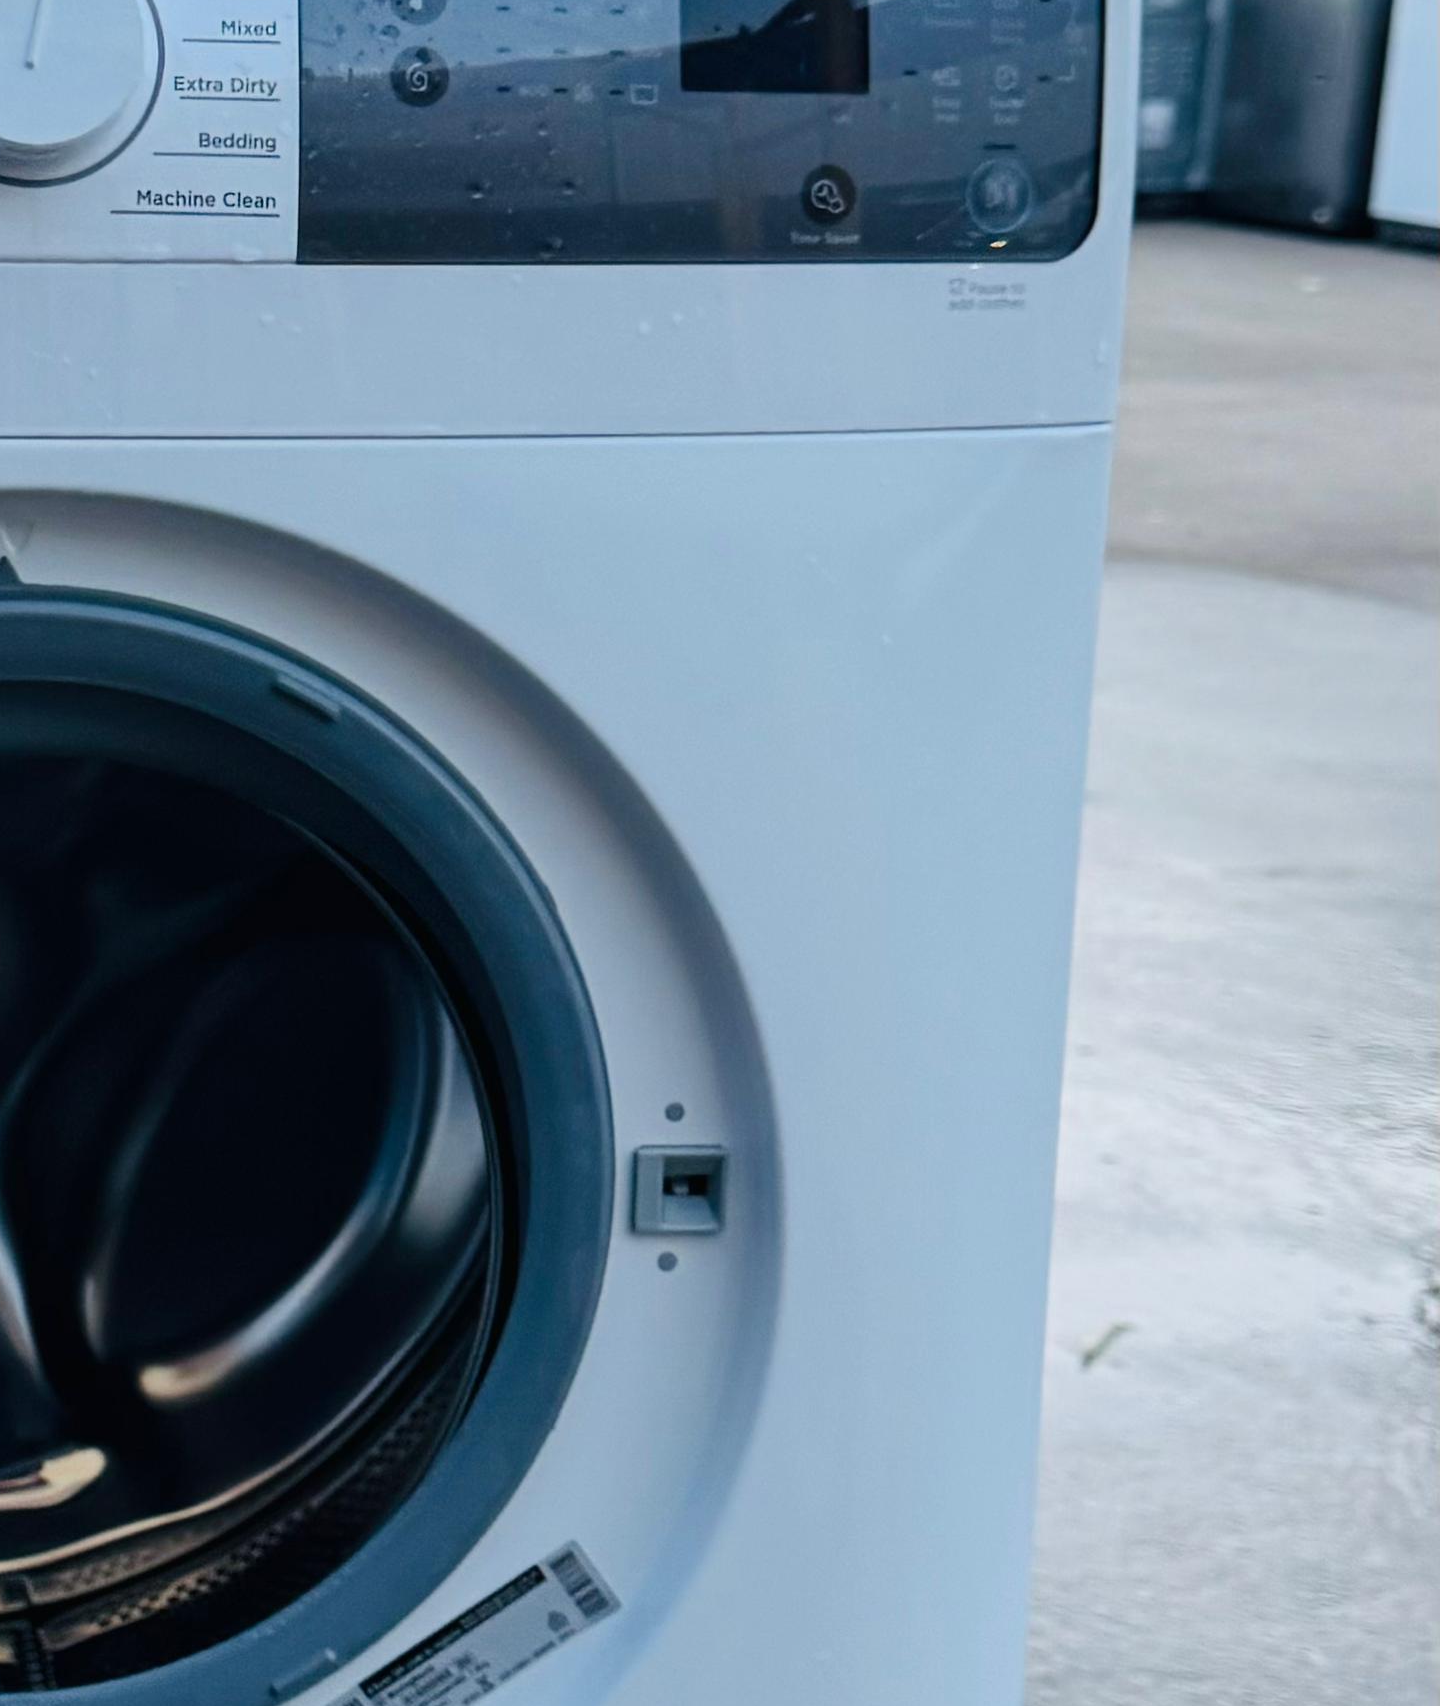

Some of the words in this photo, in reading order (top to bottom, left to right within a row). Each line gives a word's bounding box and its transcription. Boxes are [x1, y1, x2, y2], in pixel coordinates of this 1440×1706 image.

[221, 19, 277, 37] Mixed
[173, 75, 224, 92] Extra
[230, 77, 278, 97] Dirty
[198, 132, 277, 153] Bedding
[136, 189, 216, 208] Machine
[222, 191, 277, 209] Clean
